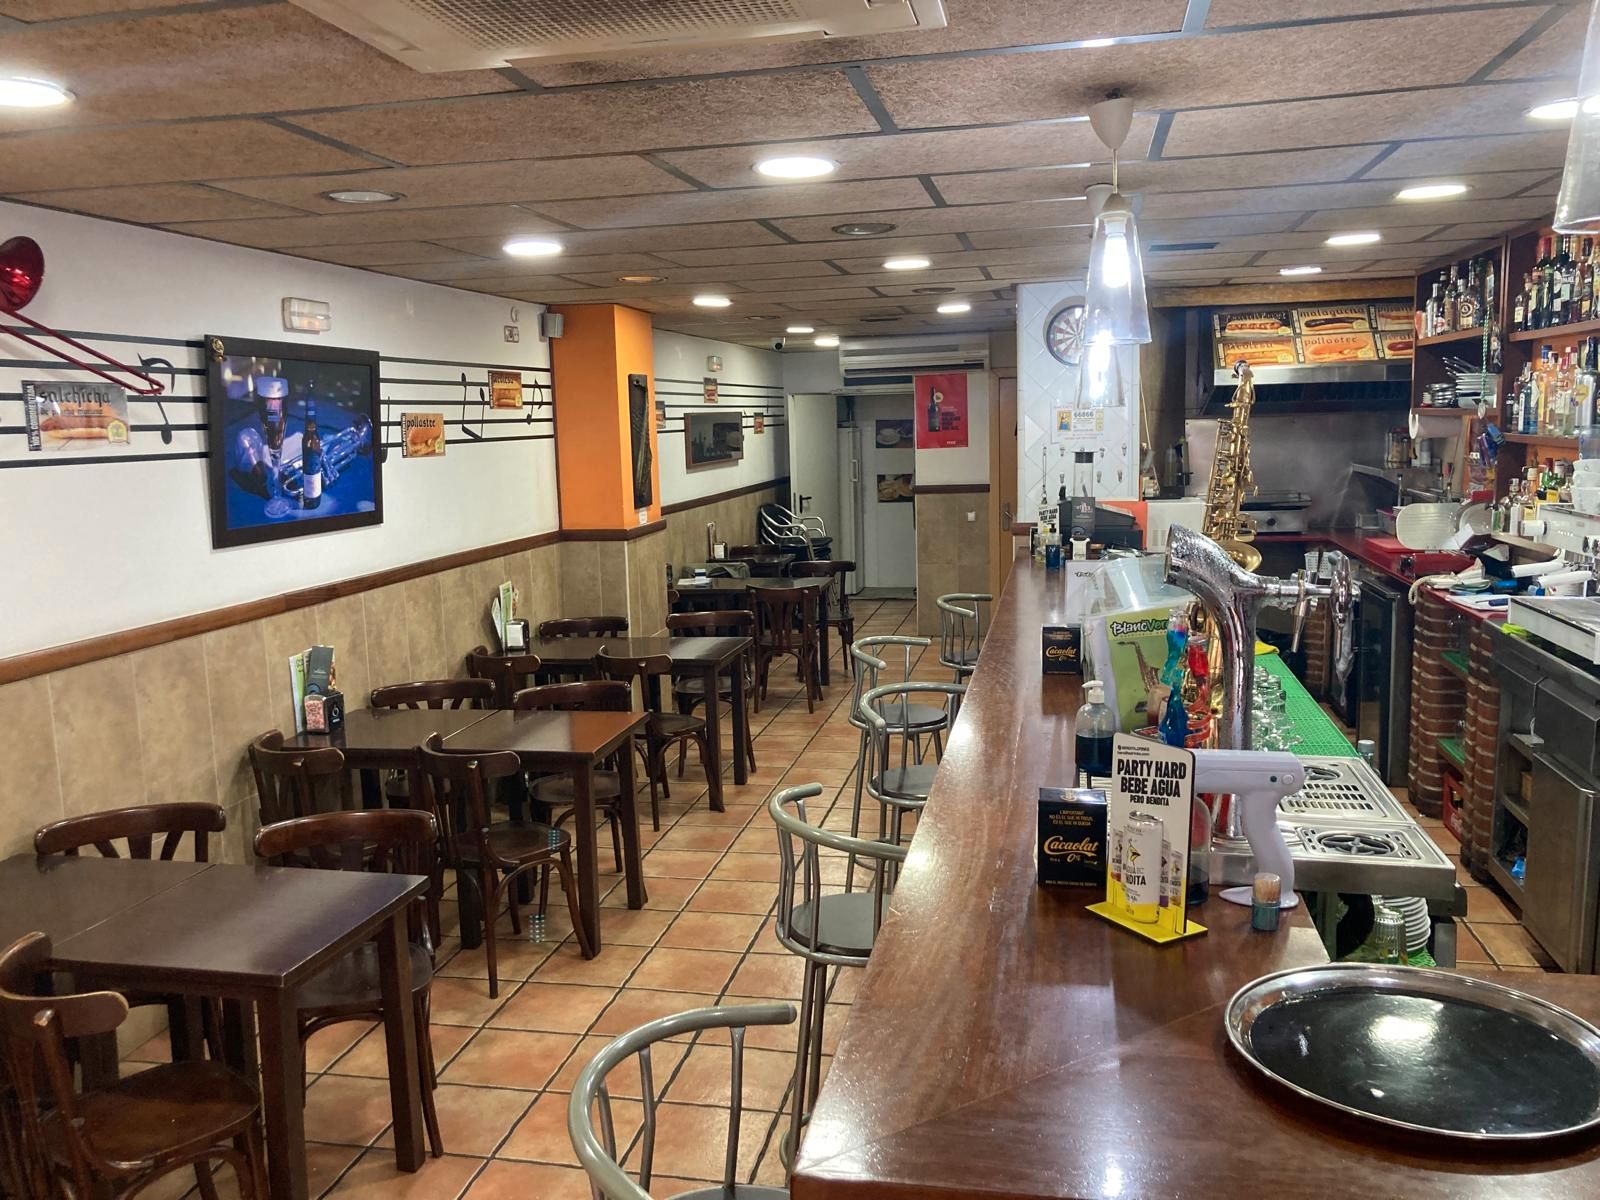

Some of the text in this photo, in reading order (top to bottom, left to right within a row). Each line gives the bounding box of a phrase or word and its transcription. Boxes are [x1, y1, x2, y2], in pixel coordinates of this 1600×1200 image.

[39, 386, 111, 408] salchicha
[1046, 646, 1077, 658] Cacaolat
[1117, 759, 1187, 780] PARTY HARD
[1121, 776, 1181, 798] BEBE AGUA
[1130, 794, 1170, 807] PERO BENDITA
[1044, 835, 1099, 857] Cacaolat
